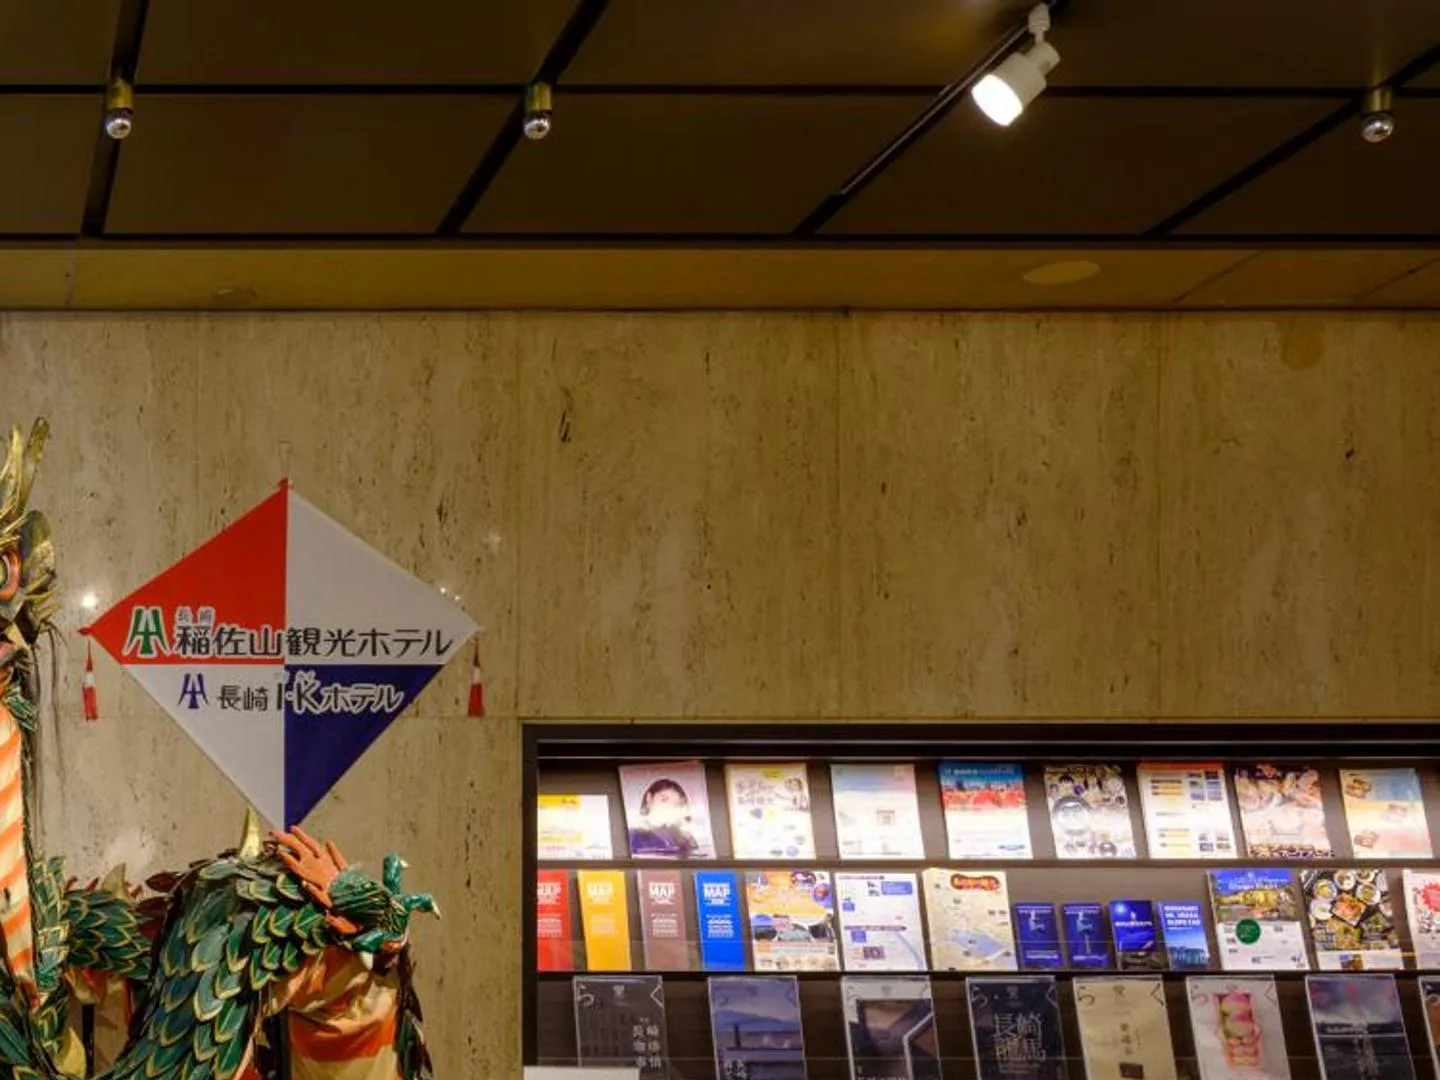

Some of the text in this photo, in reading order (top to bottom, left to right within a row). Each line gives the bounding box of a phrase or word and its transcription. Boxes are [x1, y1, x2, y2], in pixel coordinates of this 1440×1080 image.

[176, 626, 454, 659] 稲佐山観光ホテル
[648, 885, 676, 898] MAP
[703, 885, 731, 898] MAP
